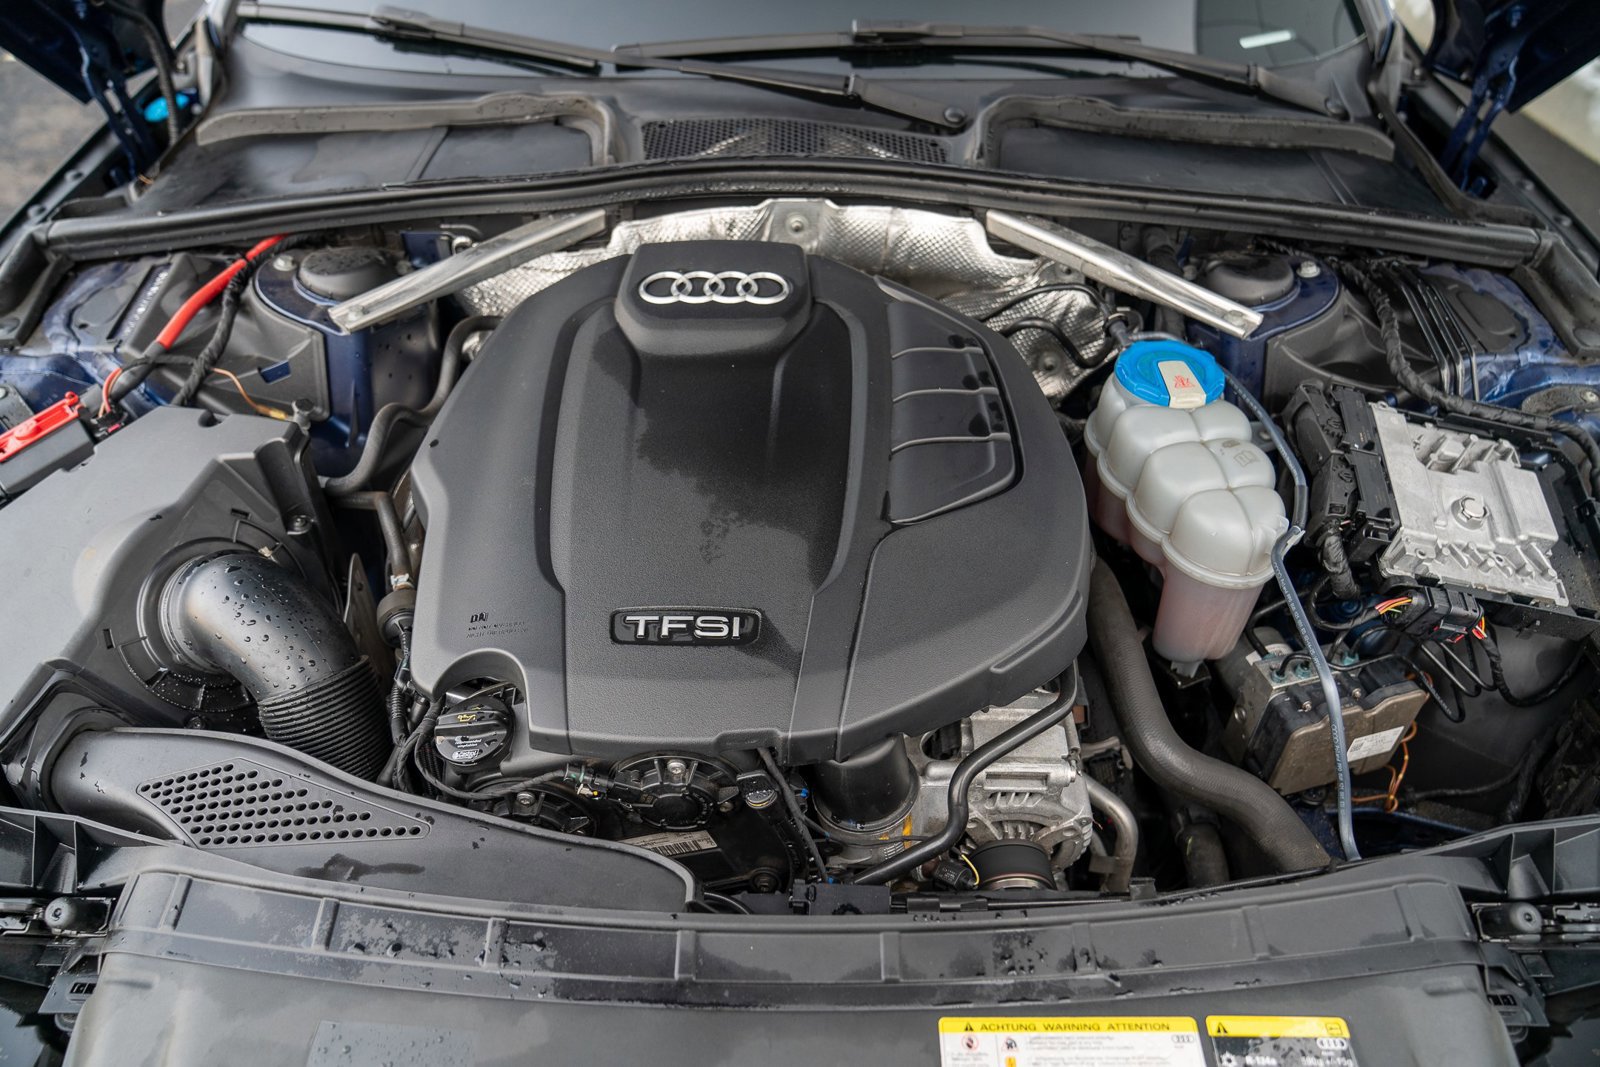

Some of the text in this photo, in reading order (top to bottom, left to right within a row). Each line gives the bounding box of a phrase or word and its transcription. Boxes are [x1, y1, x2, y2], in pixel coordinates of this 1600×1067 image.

[625, 615, 742, 640] TFSI
[980, 1023, 1171, 1032] ACHTUNG WARNING ATTENTION
